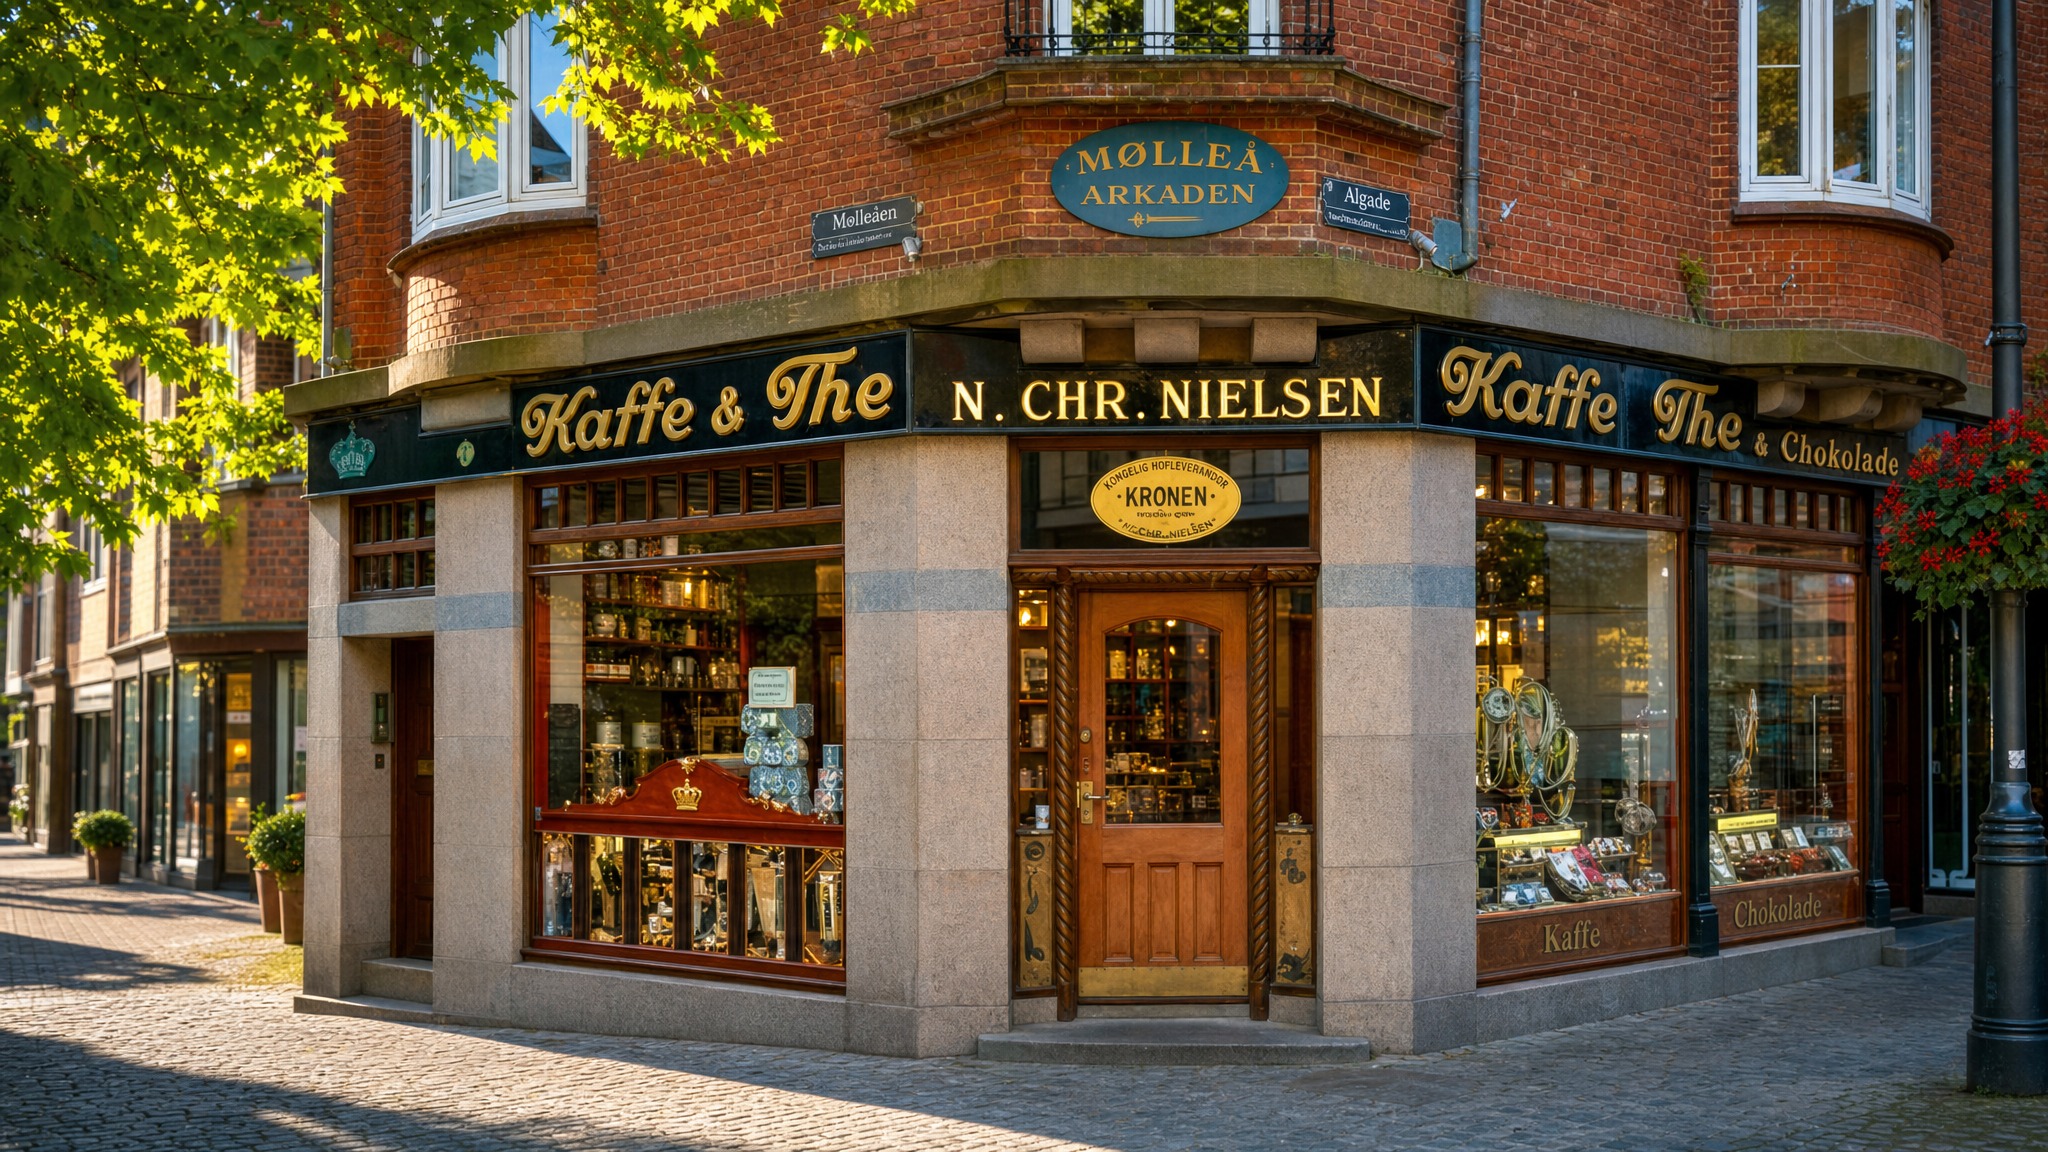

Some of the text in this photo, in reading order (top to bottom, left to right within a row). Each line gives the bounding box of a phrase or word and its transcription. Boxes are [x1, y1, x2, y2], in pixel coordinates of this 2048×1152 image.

[1077, 140, 1263, 174] MØLLEÅ
[1080, 183, 1255, 205] ARKADEN
[1344, 186, 1391, 211] Algade
[520, 345, 895, 458] Kaffe & The
[951, 376, 1383, 422] N. CHR. NIELSEN
[1441, 345, 1900, 477] Kaffe The & Chokolade
[1103, 462, 1149, 490] KONGELIG
[1125, 486, 1207, 507] KRONEN
[1734, 892, 1822, 928] Chokolade
[1543, 919, 1601, 954] Kaffe
